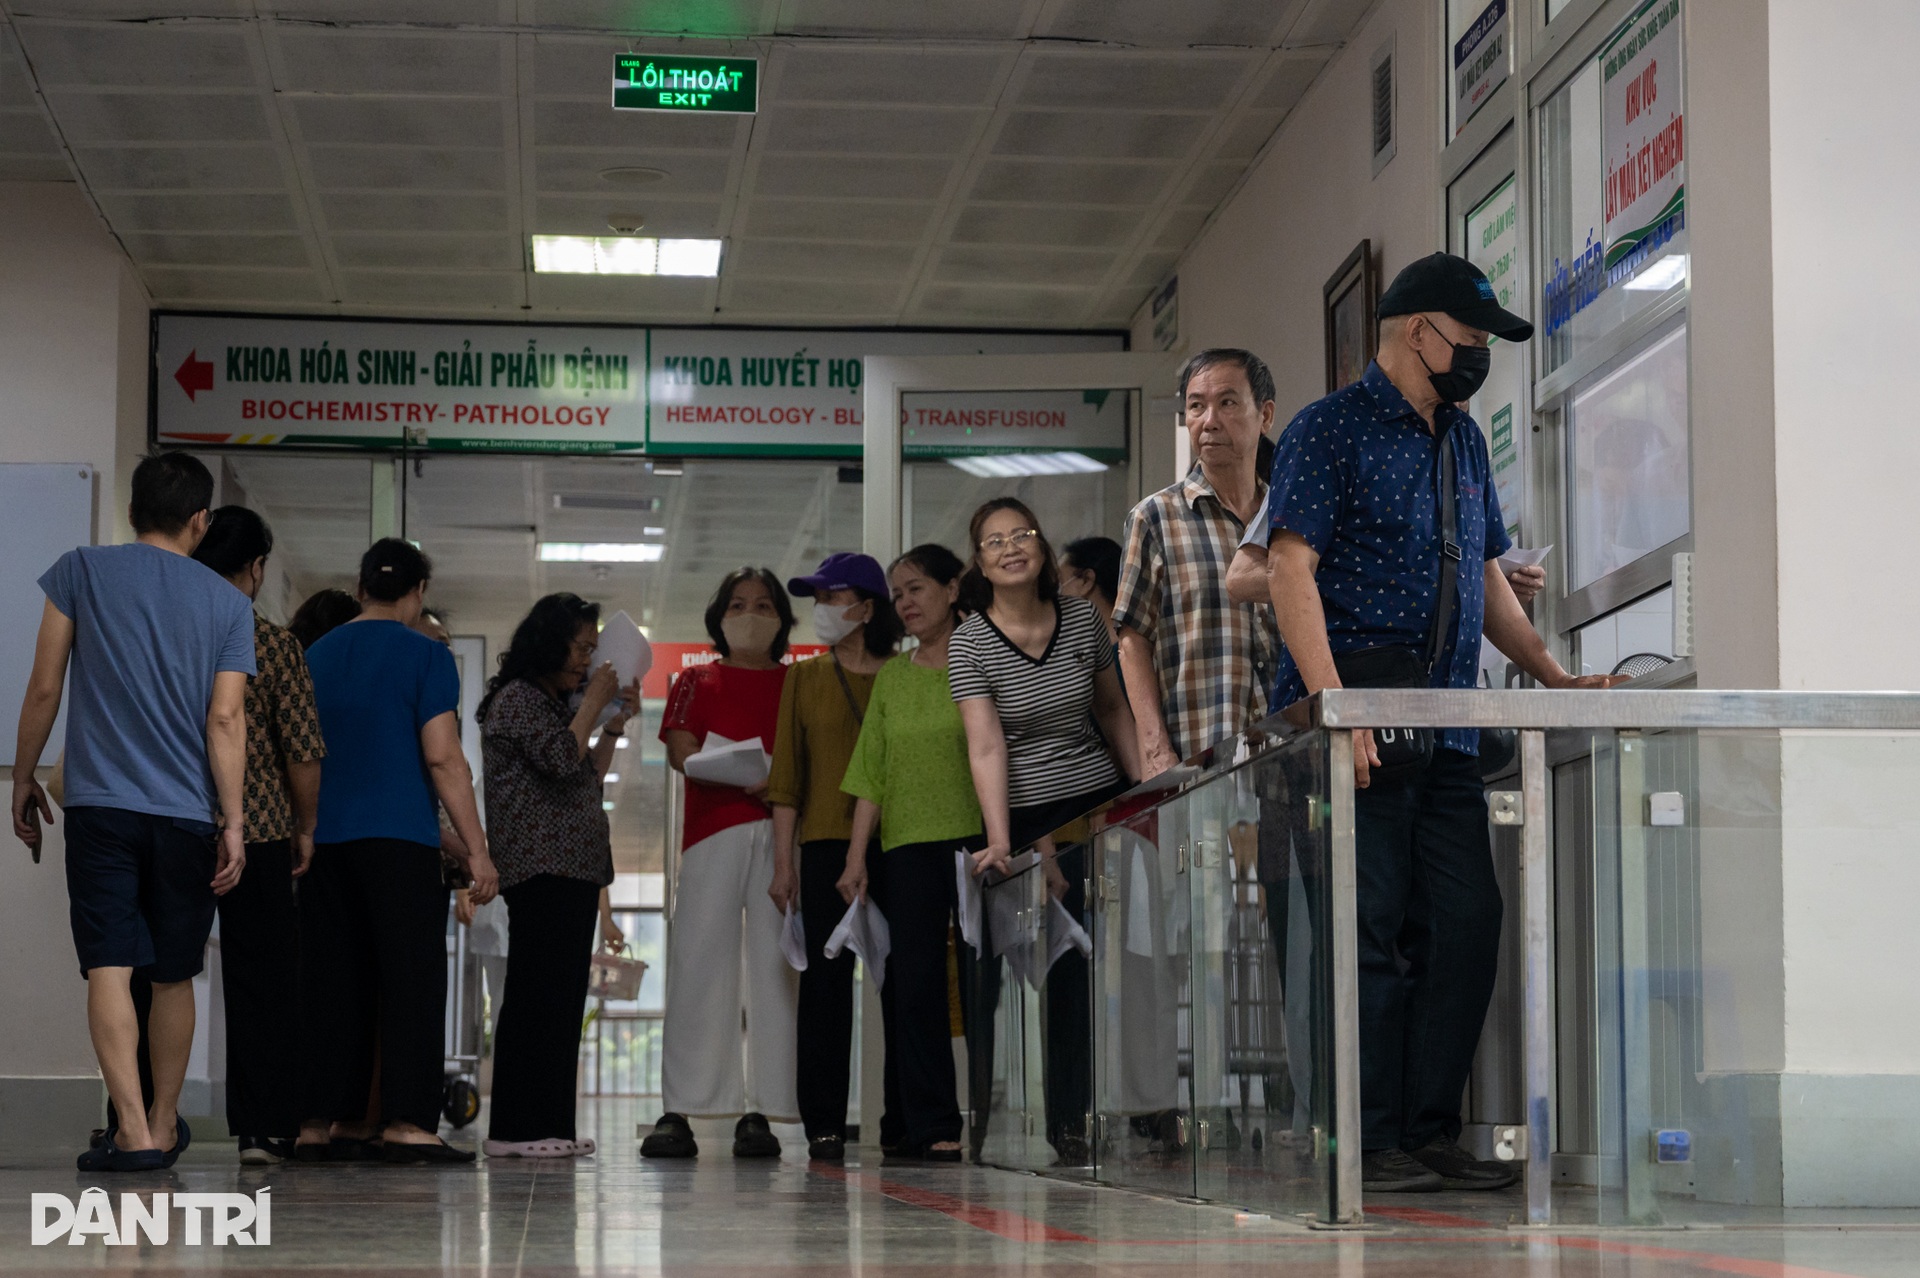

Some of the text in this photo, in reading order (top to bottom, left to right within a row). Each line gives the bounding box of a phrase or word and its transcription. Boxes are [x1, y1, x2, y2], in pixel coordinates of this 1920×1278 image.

[1462, 25, 1481, 57] PHÒNG
[630, 62, 743, 92] LỐI THOÁT
[1626, 58, 1657, 126] KHU VỰC
[659, 92, 712, 106] EXIT
[1605, 112, 1683, 224] LẤY MẪU XÉT NGHIỆM
[1505, 201, 1516, 230] VIỆ
[226, 346, 292, 383] KHOA
[300, 340, 349, 384] HÓA
[357, 349, 416, 385] SINH
[434, 339, 482, 387] GIẢI
[490, 338, 556, 388] PHẪU
[563, 346, 629, 398] BỆNH
[664, 347, 864, 395] KHOA HUYẾT HỌ
[453, 403, 611, 426] PATHOLOGY
[666, 406, 815, 425] HEMATOLOGY
[916, 409, 1066, 428] TRANSFUSION
[461, 439, 616, 451] www.benhvienducgiang.com
